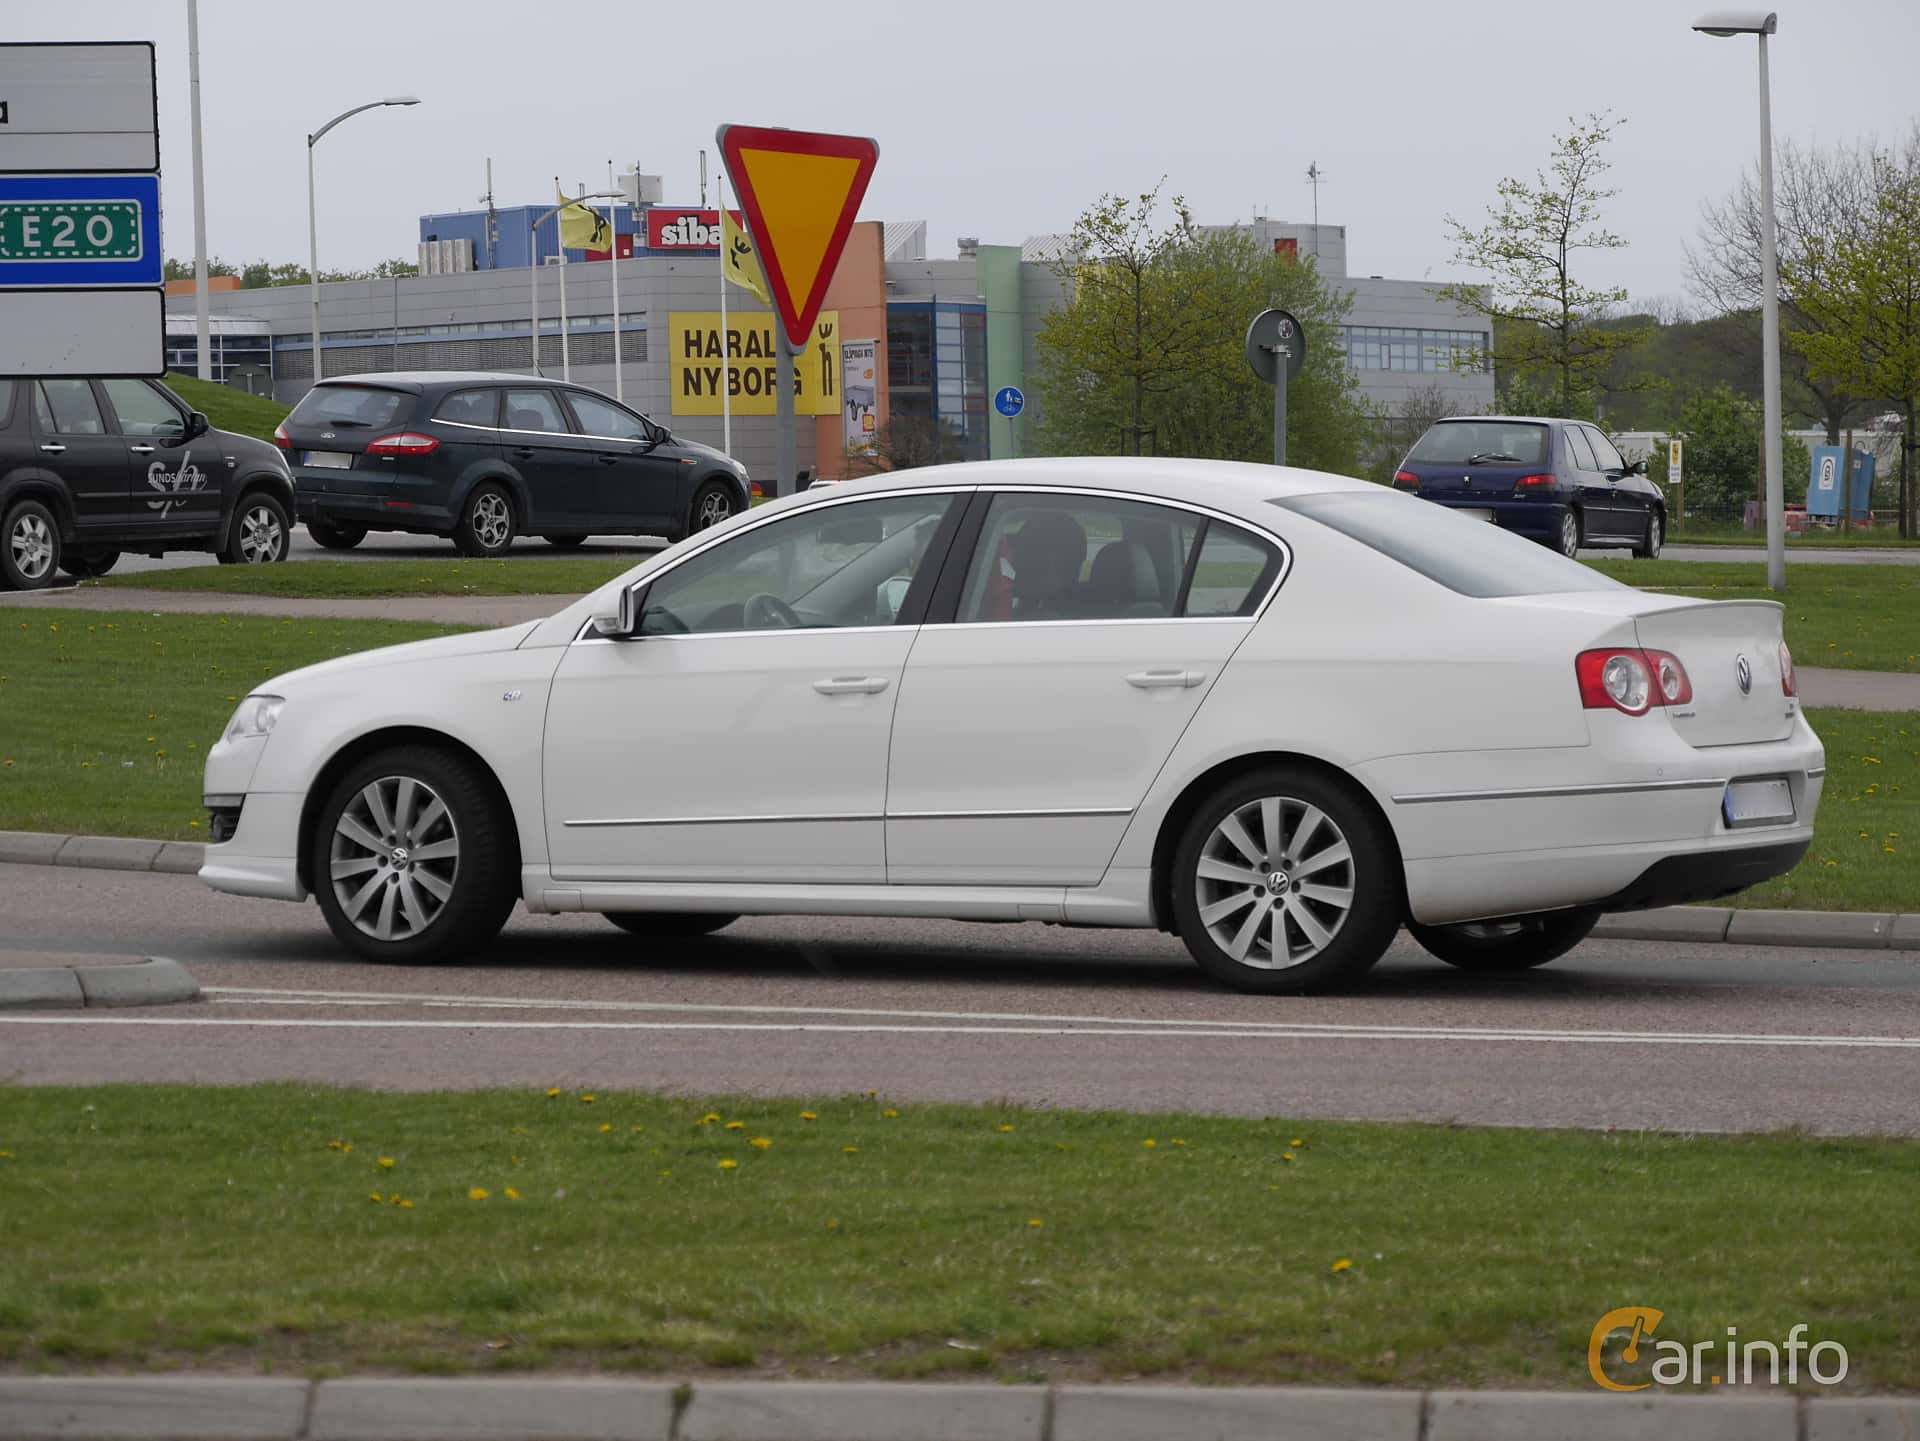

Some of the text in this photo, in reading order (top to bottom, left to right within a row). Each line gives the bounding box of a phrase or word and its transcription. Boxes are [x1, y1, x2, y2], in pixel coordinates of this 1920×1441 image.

[22, 214, 113, 247] E20
[660, 215, 720, 246] siba
[683, 329, 776, 358] HARAL
